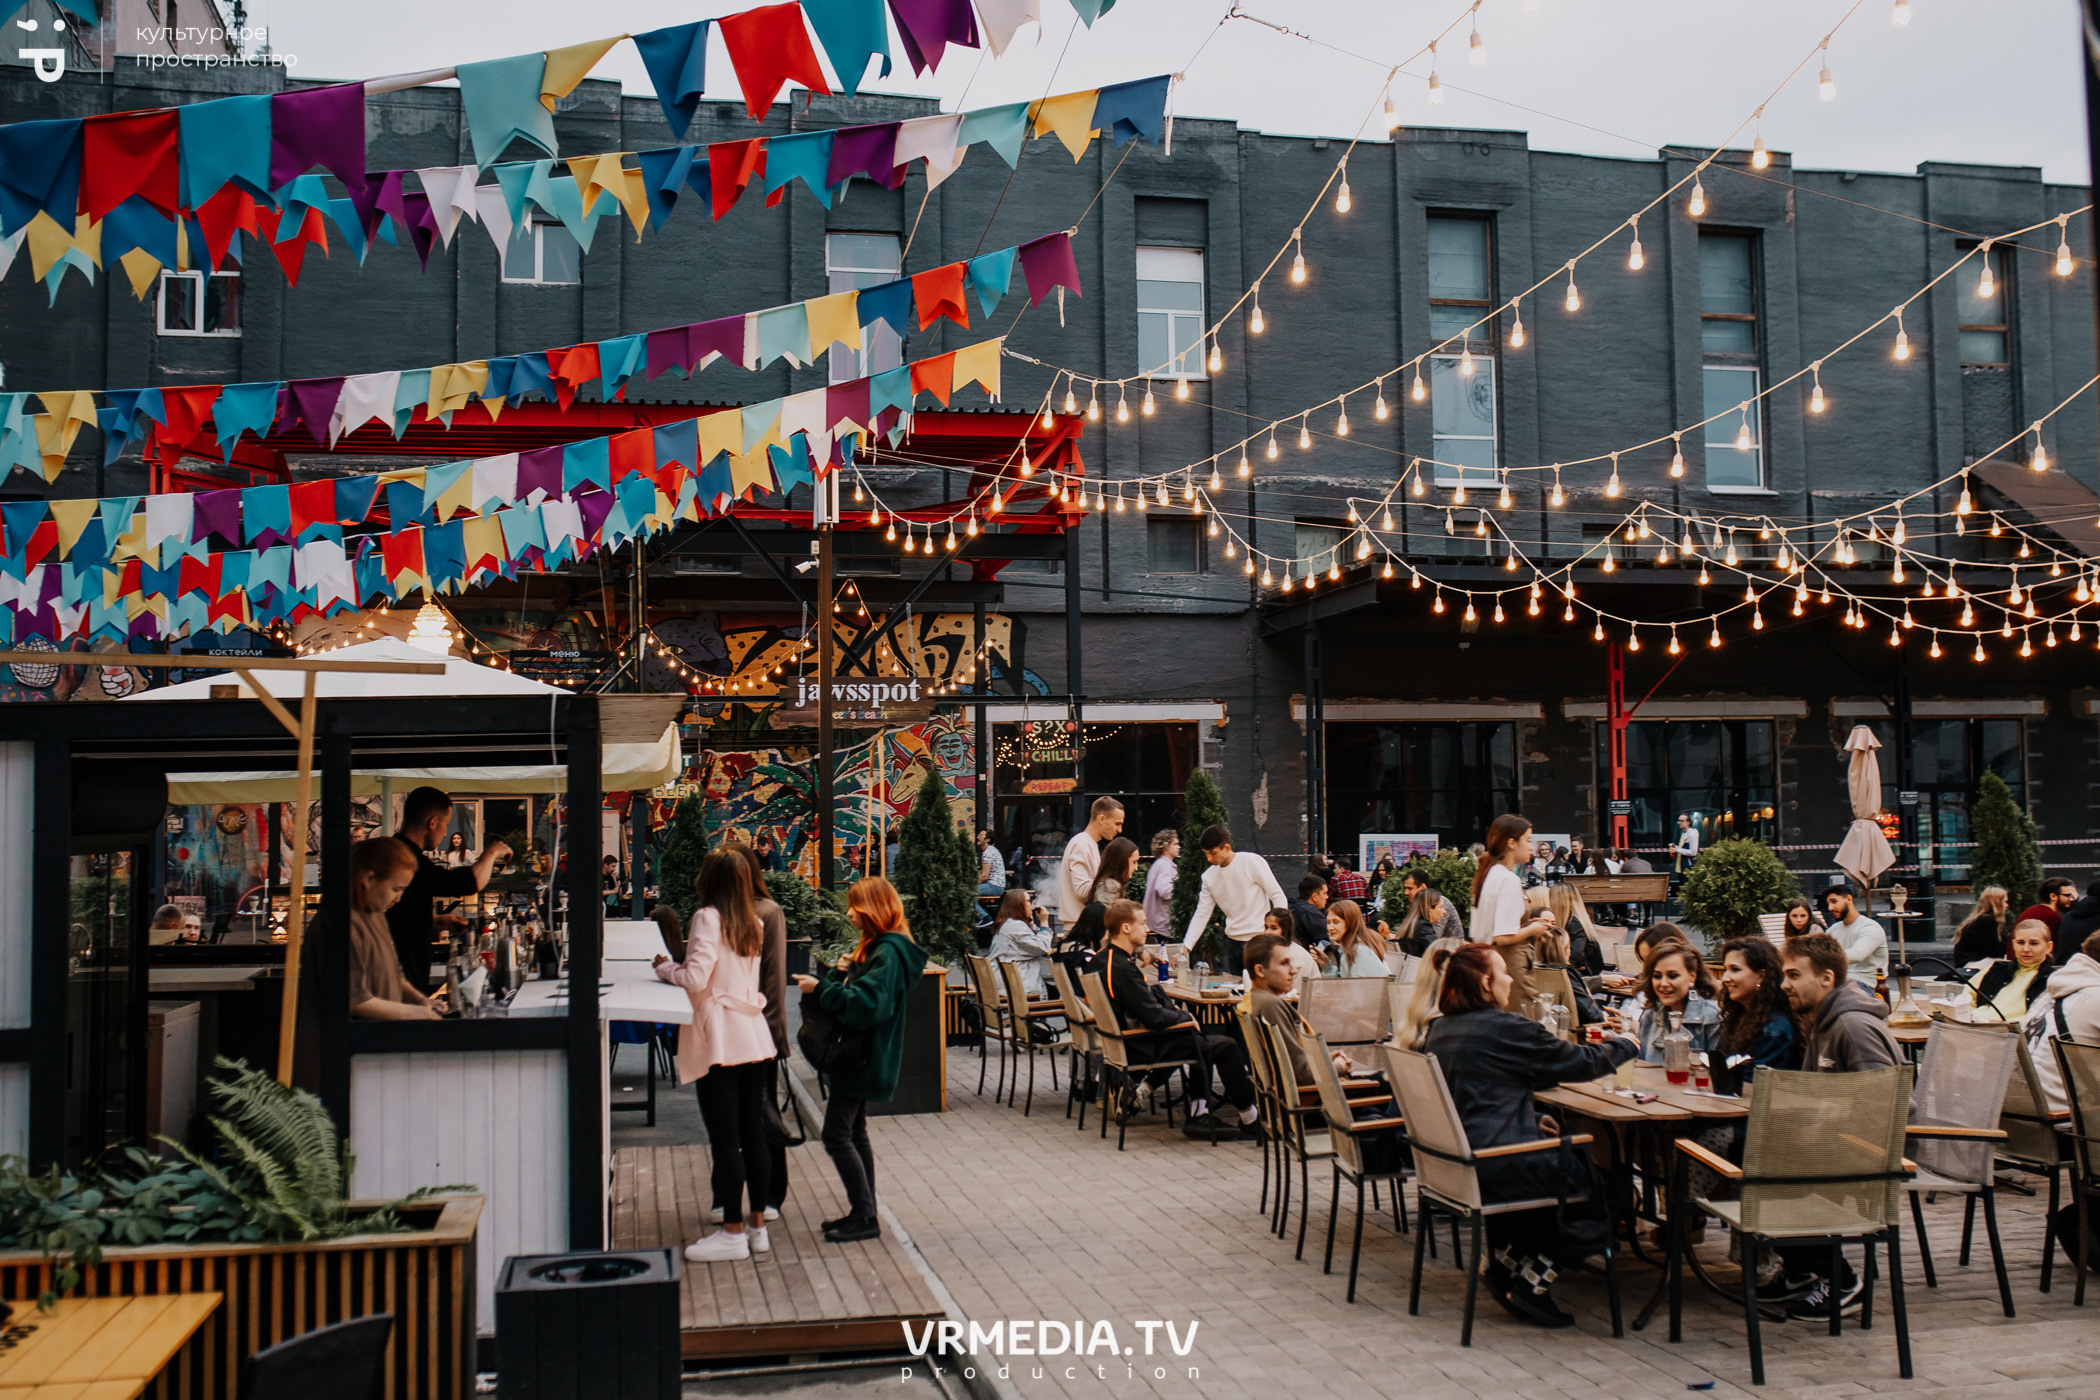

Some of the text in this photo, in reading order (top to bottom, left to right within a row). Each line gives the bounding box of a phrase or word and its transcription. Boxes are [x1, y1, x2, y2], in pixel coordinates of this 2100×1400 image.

[794, 677, 920, 709] jawsspot
[831, 705, 888, 720] eer's beach
